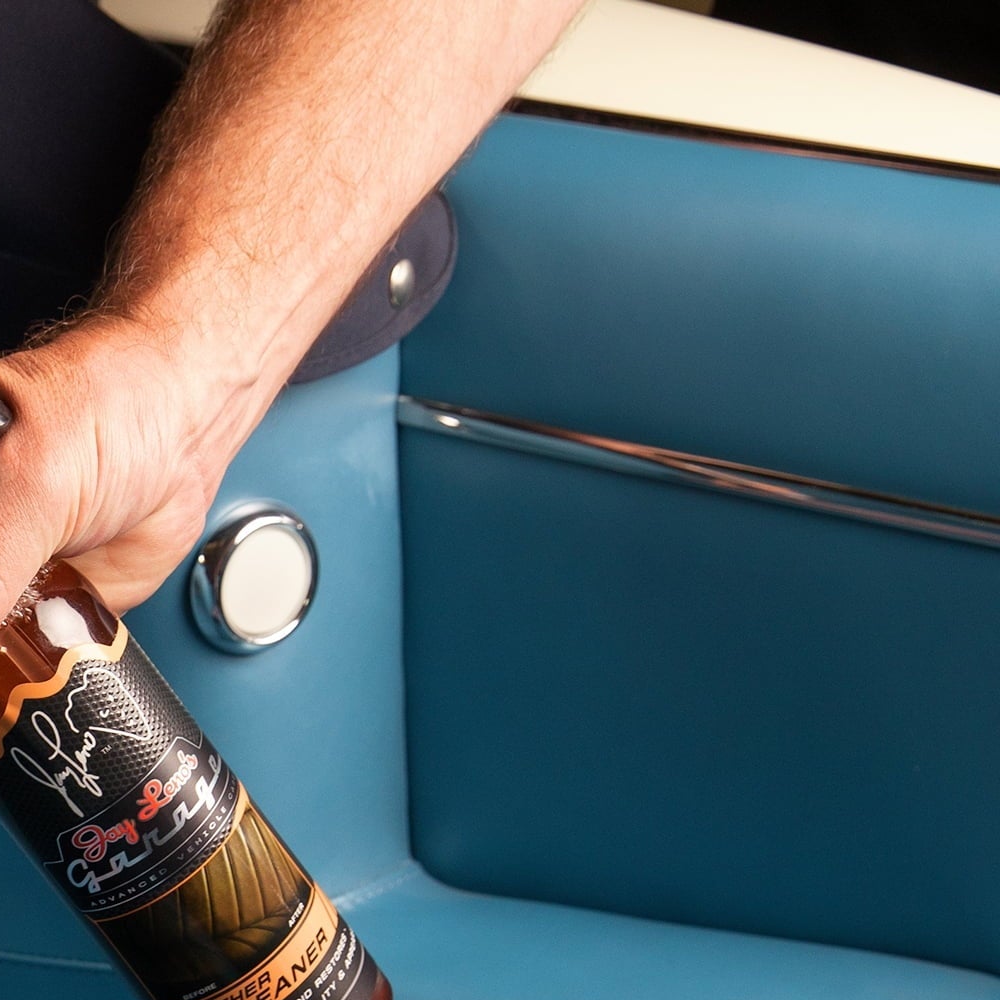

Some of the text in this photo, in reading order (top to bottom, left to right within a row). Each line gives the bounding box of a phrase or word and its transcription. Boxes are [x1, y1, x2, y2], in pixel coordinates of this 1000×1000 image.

[67, 754, 222, 893] Garage
[72, 750, 198, 862] Jay Leno's
[91, 867, 168, 907] ADVANCED
[177, 806, 227, 860] VEHICLE
[288, 902, 304, 928] AFTER
[314, 932, 347, 988] RESTORES
[338, 969, 345, 981] &
[182, 982, 217, 1000] BEFORE
